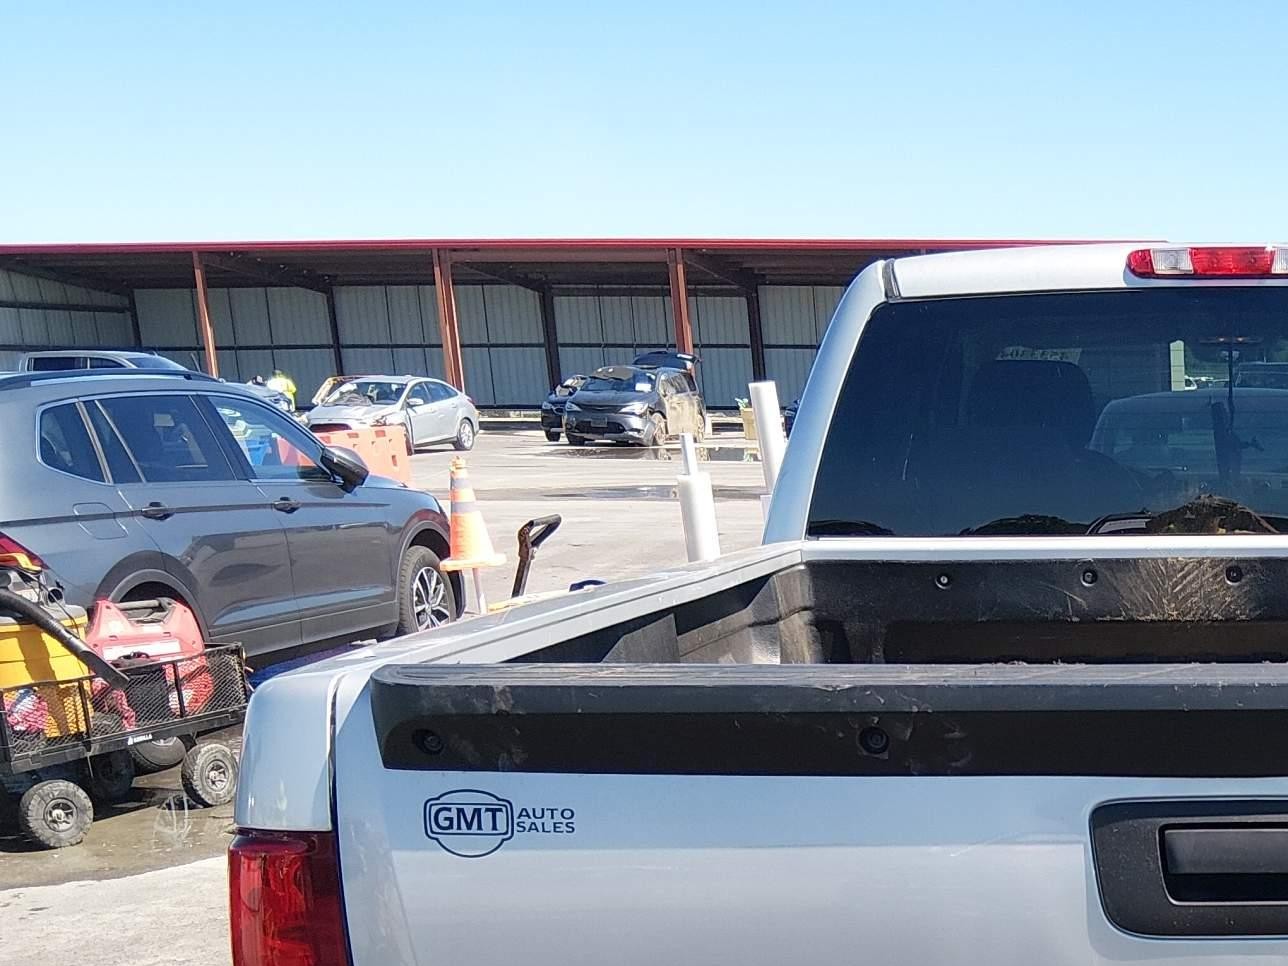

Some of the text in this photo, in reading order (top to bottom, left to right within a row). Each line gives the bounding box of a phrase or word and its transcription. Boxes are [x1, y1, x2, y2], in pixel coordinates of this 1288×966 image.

[433, 806, 504, 832] GMT
[516, 807, 575, 820] AUTO
[516, 821, 575, 834] SALES
